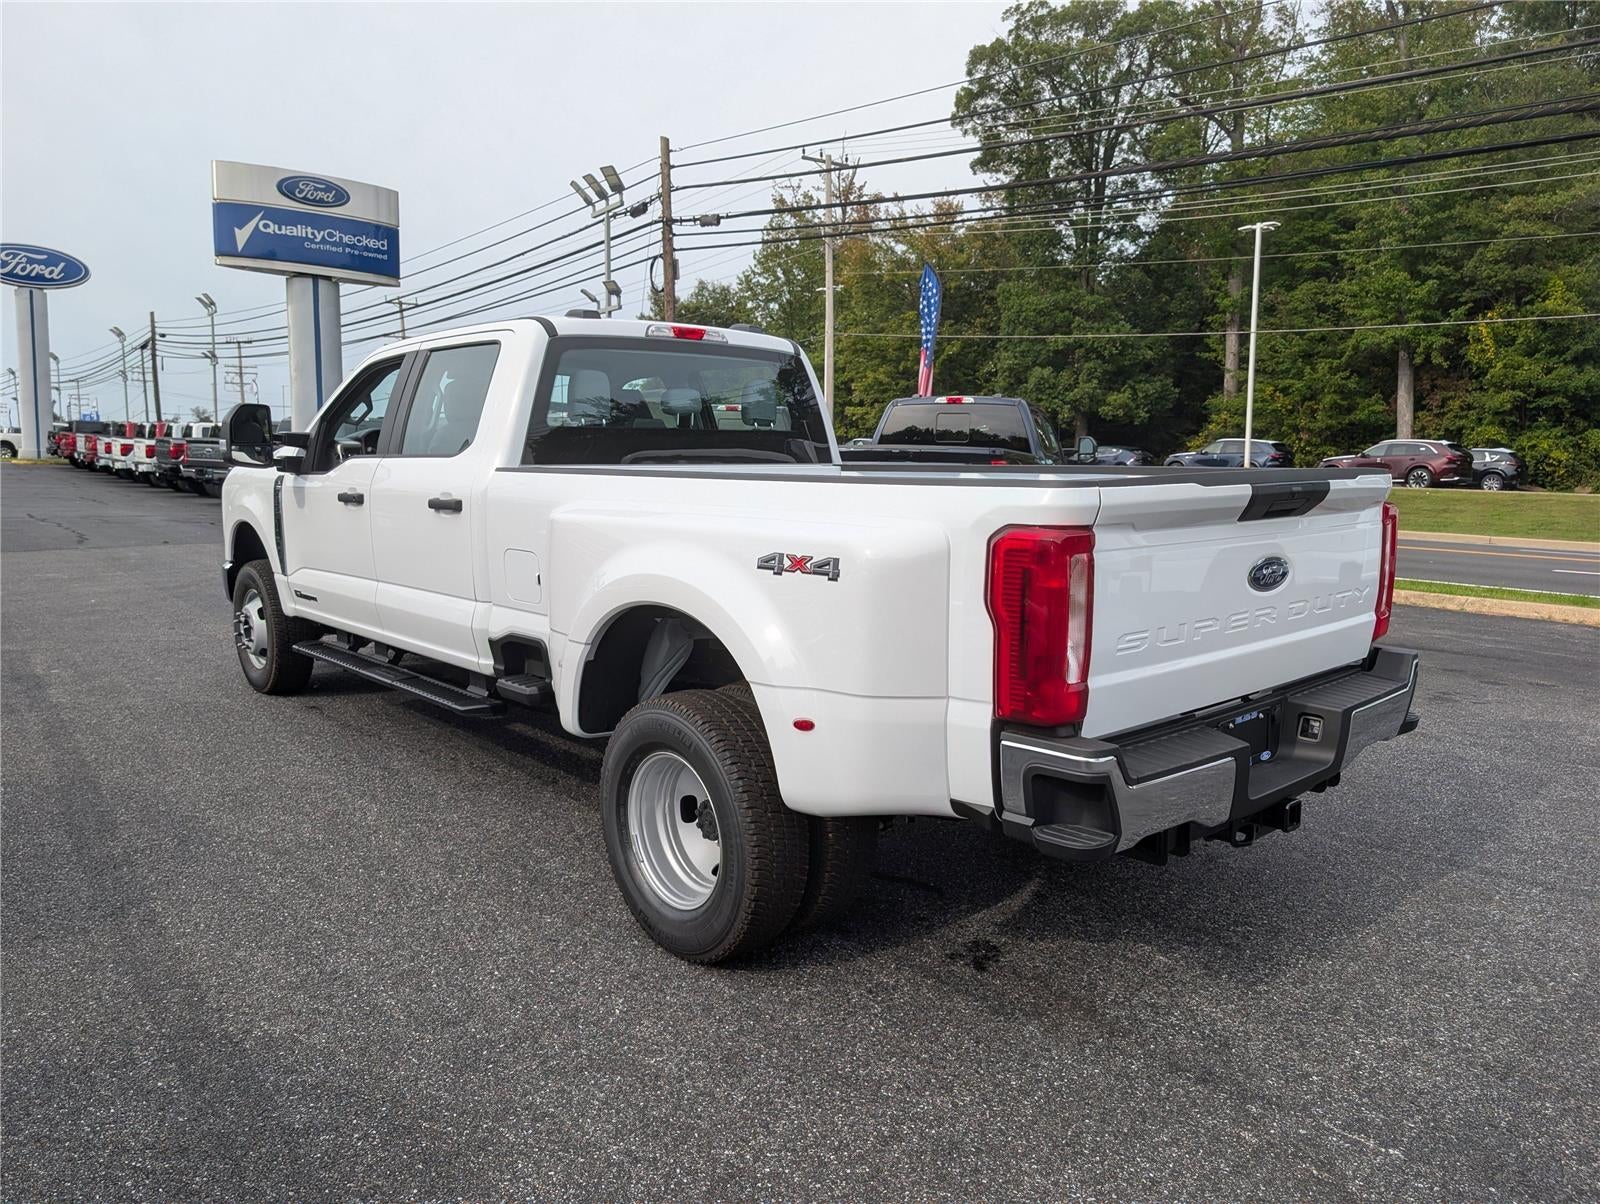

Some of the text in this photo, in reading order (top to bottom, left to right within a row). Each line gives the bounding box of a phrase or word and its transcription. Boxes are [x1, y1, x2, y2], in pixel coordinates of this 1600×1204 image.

[295, 181, 336, 202] Ford
[304, 241, 388, 261] Certified Pre-owned
[0, 249, 66, 280] Ford
[1115, 586, 1370, 656] SUPER DUTY
